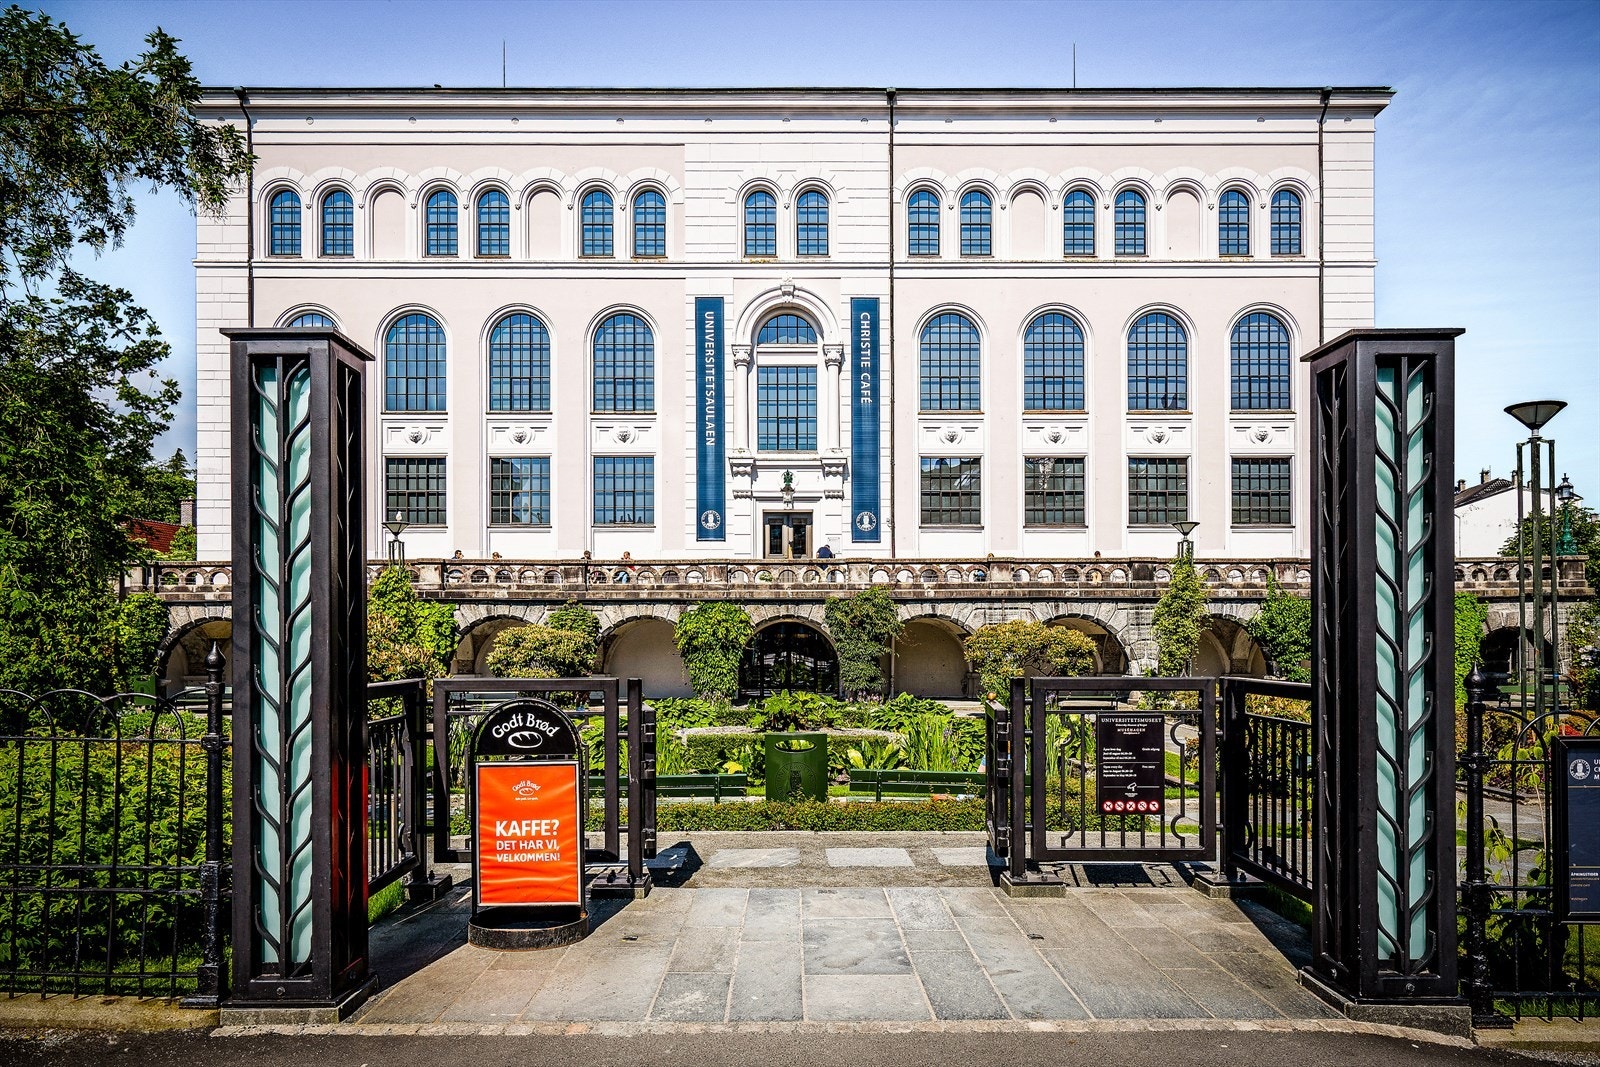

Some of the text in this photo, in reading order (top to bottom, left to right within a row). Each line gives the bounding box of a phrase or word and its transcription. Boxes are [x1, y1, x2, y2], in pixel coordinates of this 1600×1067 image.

[860, 312, 873, 405] CHRISTIE CAFÉ
[704, 311, 715, 446] UNIVERSITETSAULAEN
[492, 713, 560, 738] Godt Brød
[495, 819, 559, 837] KAFFE?
[496, 839, 560, 851] DET HAR VI,
[496, 853, 560, 863] VELKOMMEN!
